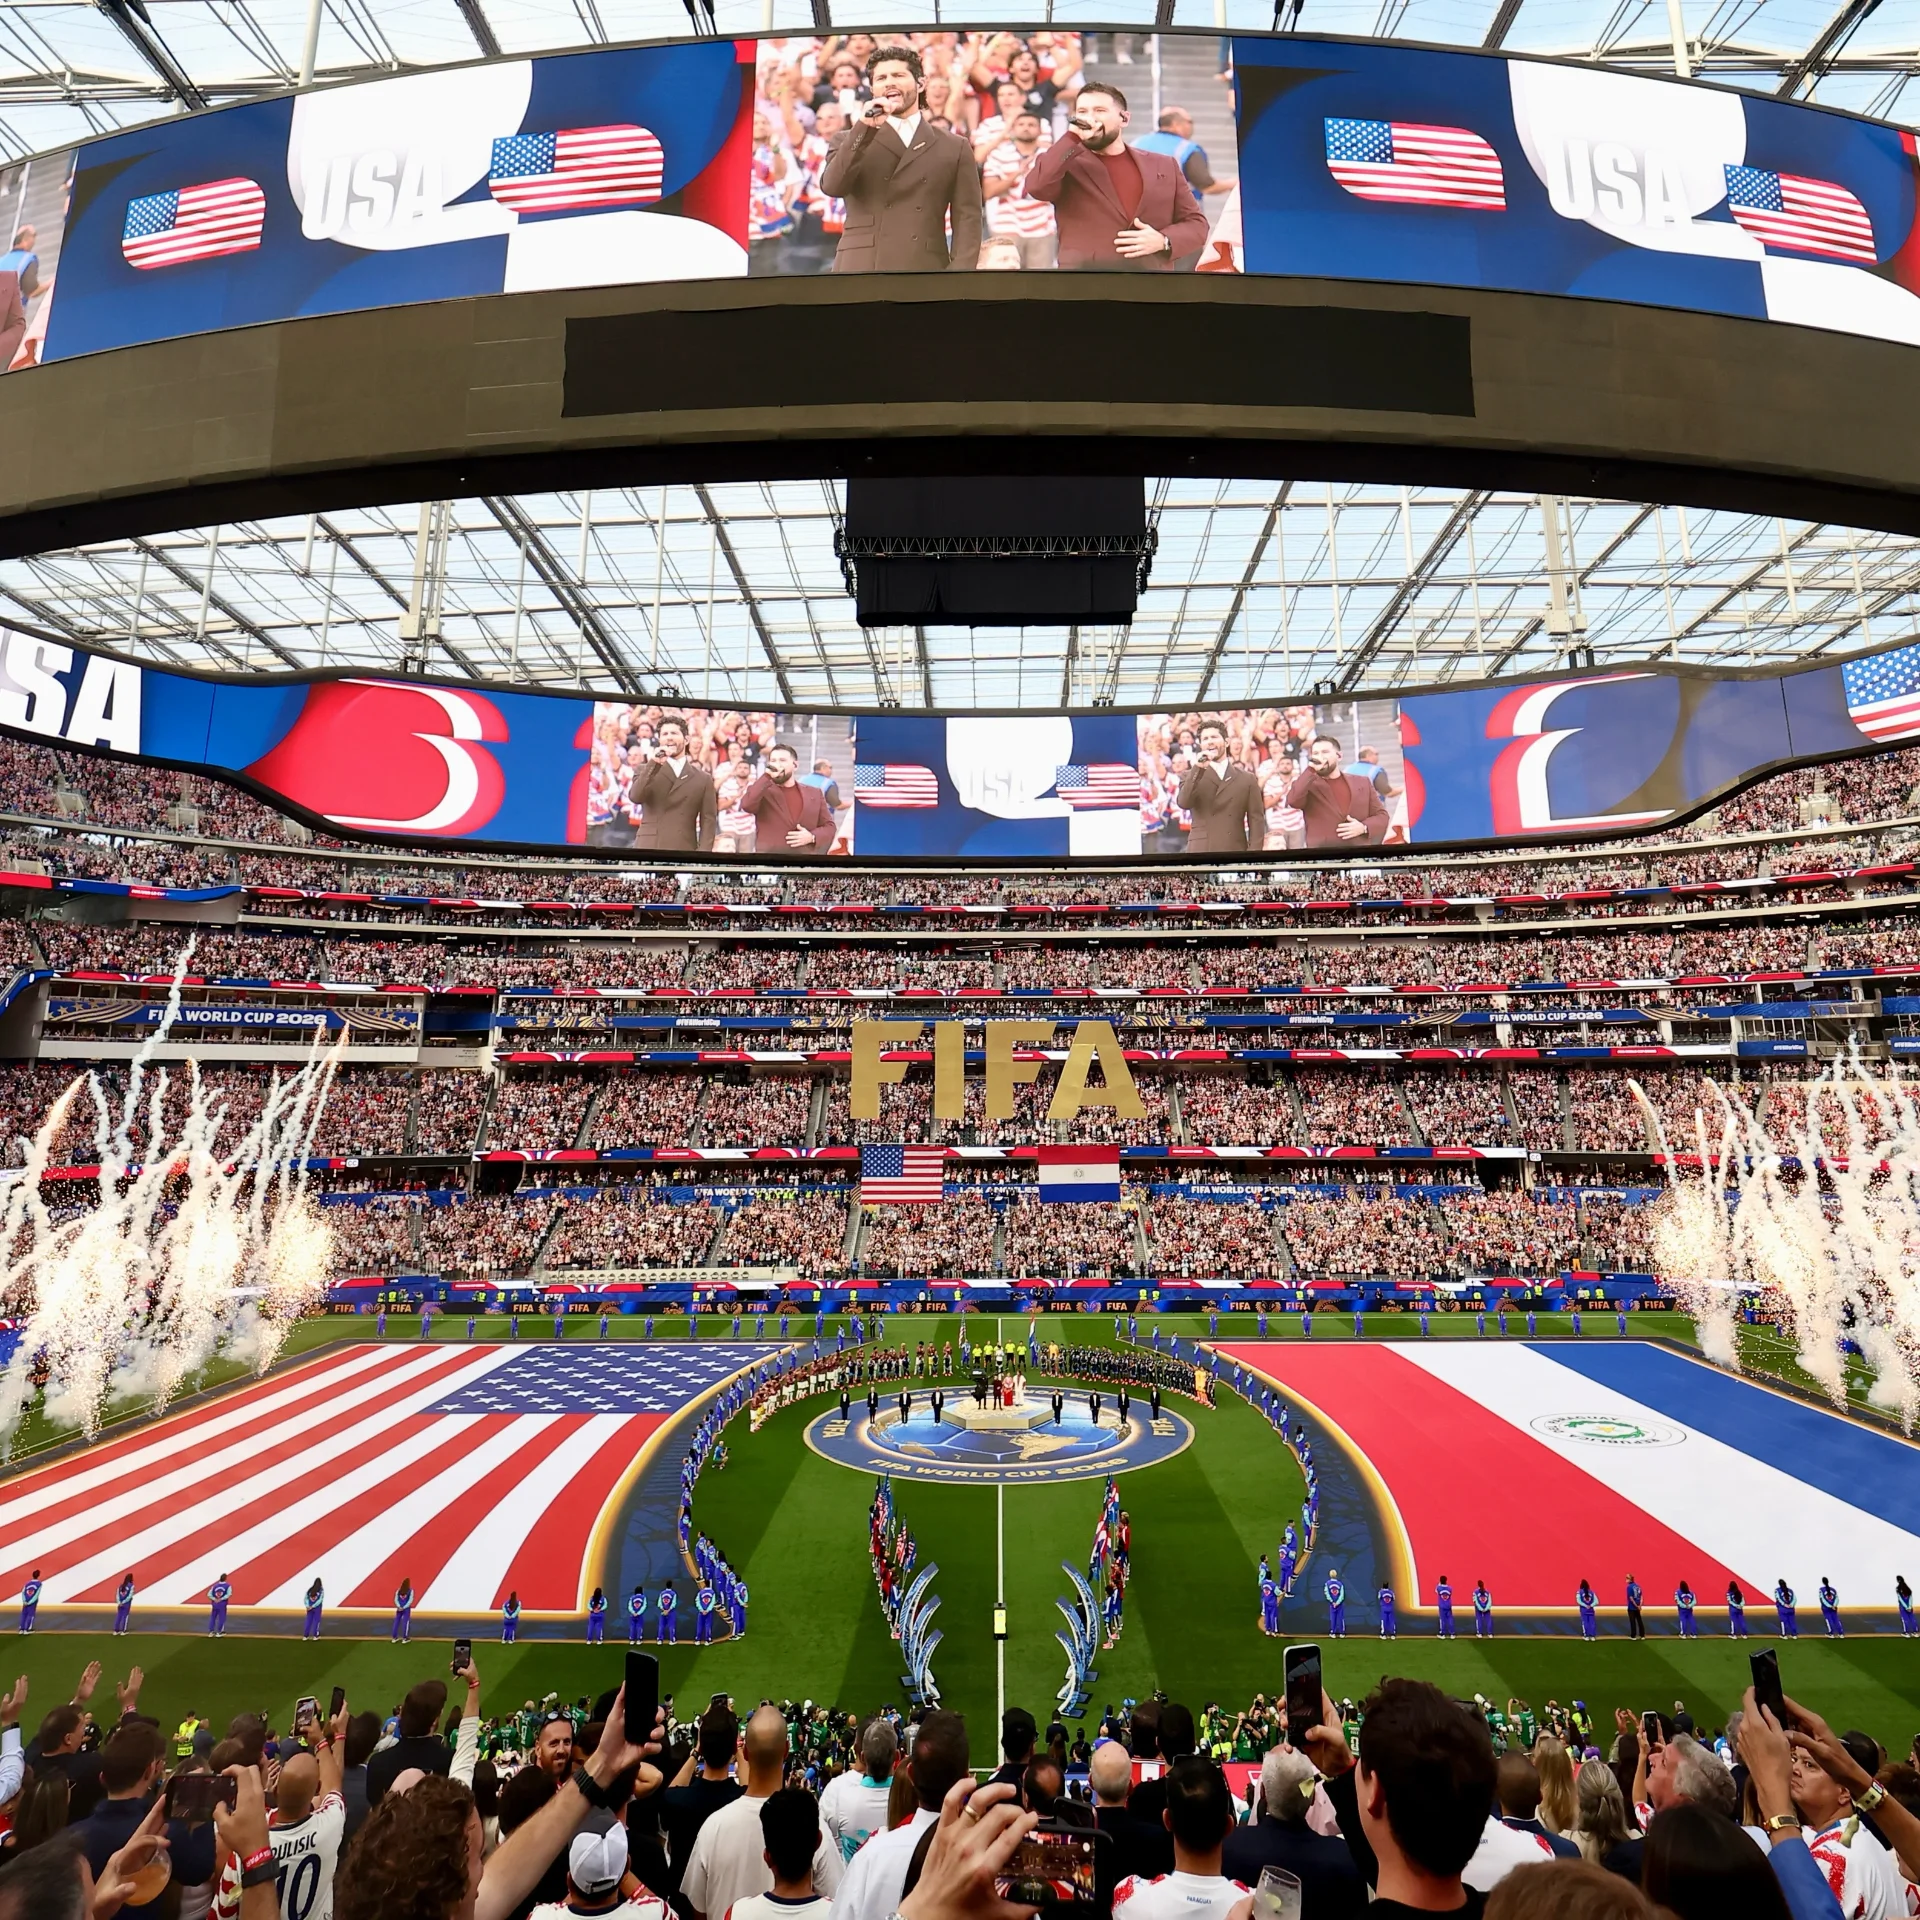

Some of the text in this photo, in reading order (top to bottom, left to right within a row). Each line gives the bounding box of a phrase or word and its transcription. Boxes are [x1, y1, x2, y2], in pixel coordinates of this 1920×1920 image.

[1547, 140, 1693, 229] USA
[302, 149, 444, 240] USA
[0, 627, 142, 755] SA
[148, 1009, 327, 1025] FIA WORLD CUP 2026
[1490, 1012, 1604, 1022] FIFA WORLD CUP 2026
[849, 1021, 1147, 1119] FIFA
[1191, 1186, 1211, 1194] FIFA
[1211, 1186, 1245, 1194] WORLD
[1245, 1186, 1264, 1194] CUP
[335, 1304, 356, 1313] FIFA
[390, 1304, 412, 1313] FIFA
[513, 1304, 534, 1313] FIFA
[568, 1304, 590, 1313] FIFA
[691, 1303, 712, 1312] FIFA
[747, 1303, 768, 1312] FIFA
[870, 1303, 892, 1312] FIFA
[926, 1303, 948, 1312] FIFA
[1051, 1302, 1072, 1311] FIFA
[1106, 1302, 1127, 1311] FIFA
[1230, 1302, 1251, 1311] FIFA
[1285, 1302, 1307, 1311] FIFA
[1409, 1301, 1430, 1310] FIFA
[1465, 1301, 1486, 1310] FIFA
[1588, 1301, 1610, 1310] FIFA
[1644, 1300, 1666, 1309] FIFA
[822, 1418, 852, 1439] FIFA
[1148, 1417, 1176, 1437] FIFA
[867, 1457, 1129, 1478] FIFA WORLD CUP 2026
